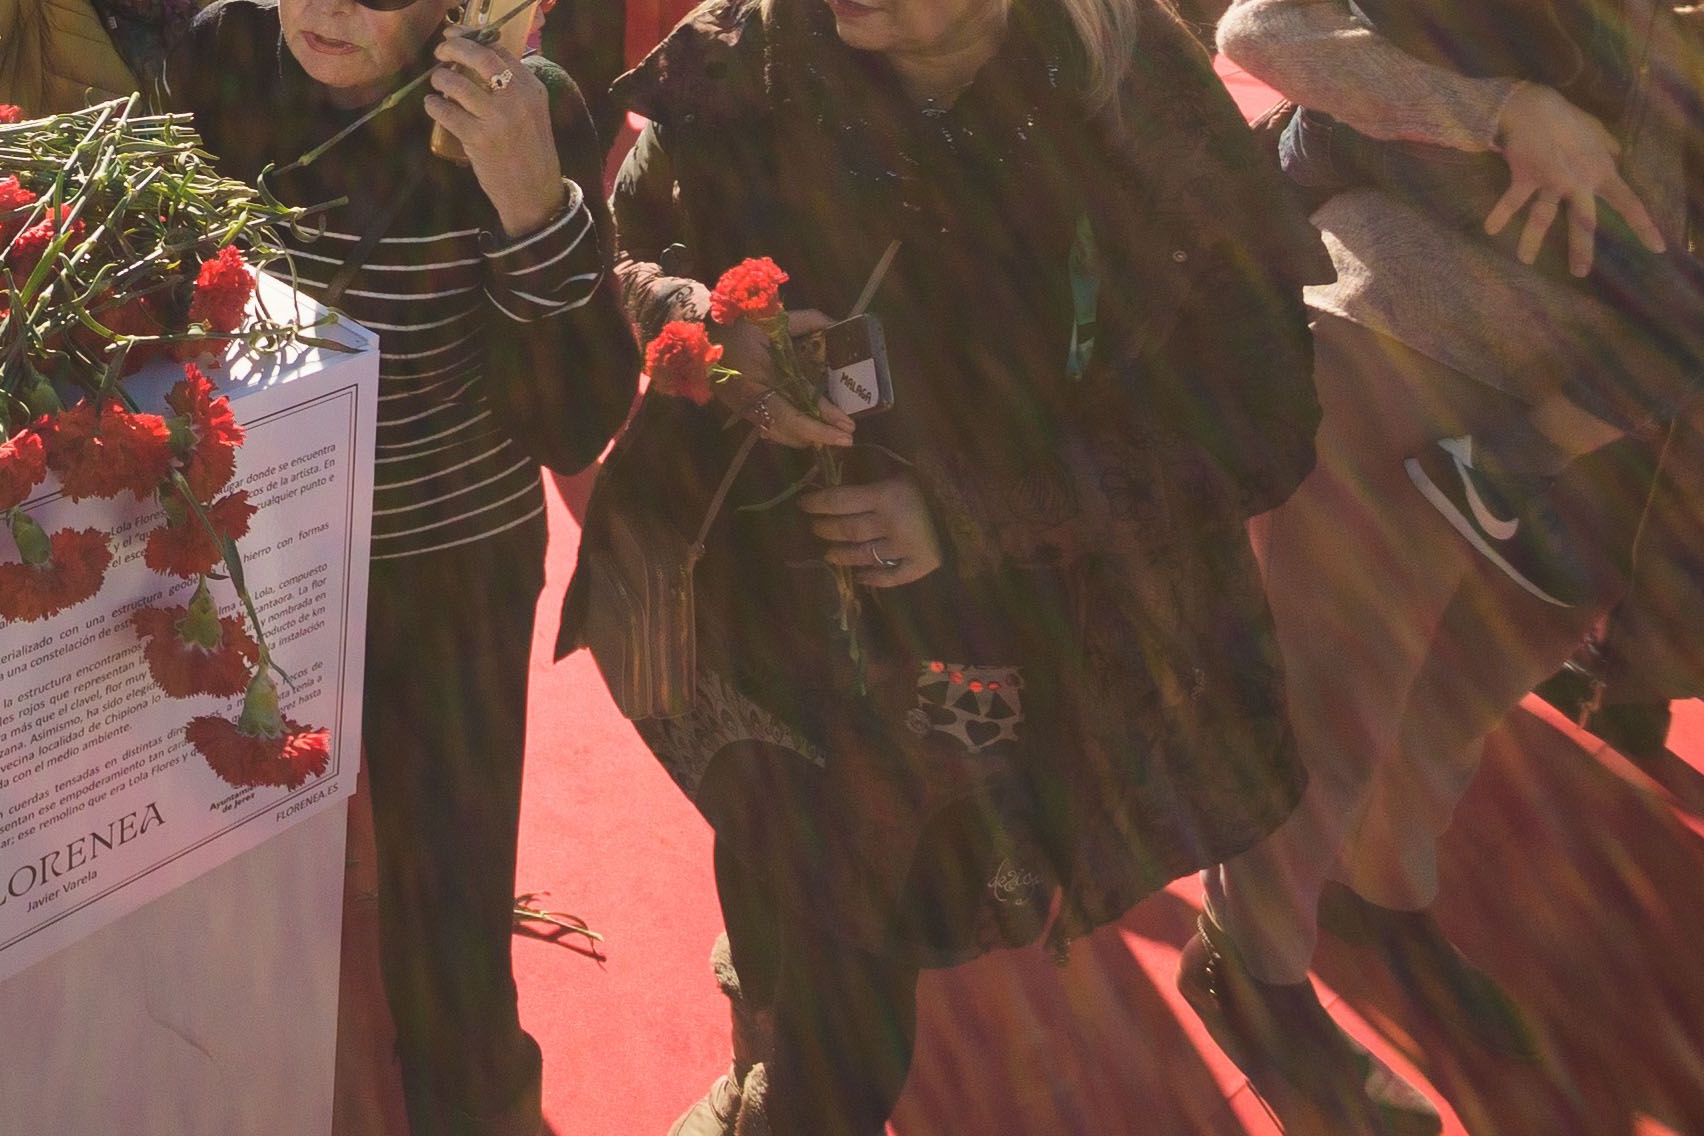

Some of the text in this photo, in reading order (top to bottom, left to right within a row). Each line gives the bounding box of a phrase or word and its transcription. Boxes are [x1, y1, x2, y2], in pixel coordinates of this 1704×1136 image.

[58, 625, 79, 640] con
[84, 614, 105, 629] una
[110, 590, 163, 618] estructura
[6, 662, 27, 678] una
[97, 626, 111, 639] de
[16, 673, 72, 702] estructura
[75, 640, 142, 677] encontramos
[17, 699, 45, 718] rojos
[48, 689, 69, 705] que
[73, 661, 135, 694] representan
[34, 711, 55, 727] que
[69, 688, 102, 711] clavel,
[104, 680, 122, 695] flor
[124, 670, 147, 686] muy
[0, 751, 35, 773] vecina
[37, 726, 85, 756] localidad
[104, 699, 148, 725] Chipiona
[29, 715, 83, 744] Asimismo,
[101, 696, 123, 712] sido
[7, 789, 49, 815] cuerdas
[54, 765, 100, 792] tensadas
[121, 735, 163, 761] distintas
[11, 768, 32, 783] con
[46, 746, 79, 767] medio
[81, 723, 132, 751] ambiente.
[16, 825, 36, 840] ese
[38, 801, 85, 830] remolino
[86, 791, 107, 807] que
[109, 782, 126, 796] era
[127, 771, 149, 787] Lola
[150, 756, 180, 776] Flores
[37, 801, 56, 815] ese
[58, 758, 145, 805] empoderamiento
[148, 749, 164, 763] tan
[209, 785, 254, 811] Ayuntami
[275, 782, 338, 822] FLORENEA.ES
[26, 870, 97, 913] Javier Varela
